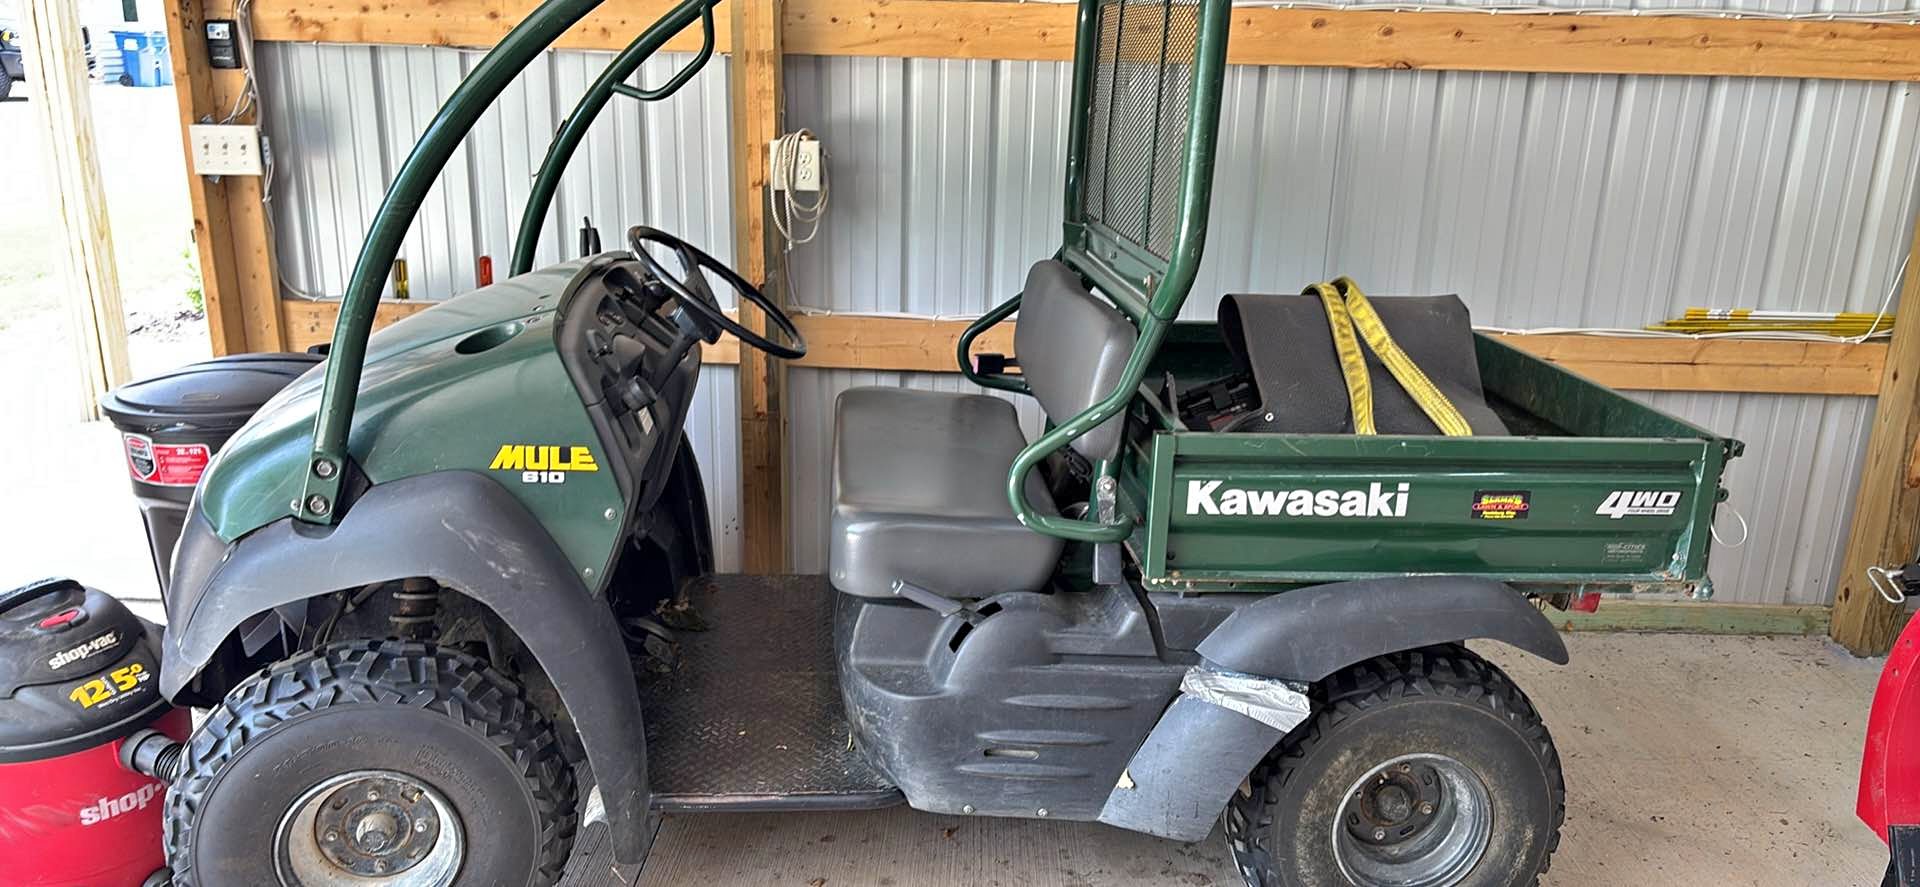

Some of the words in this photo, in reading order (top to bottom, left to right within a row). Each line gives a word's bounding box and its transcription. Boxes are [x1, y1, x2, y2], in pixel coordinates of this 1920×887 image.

[489, 445, 599, 471] MULE
[522, 471, 565, 483] 610
[1186, 480, 1410, 517] Kawasaki
[1595, 491, 1681, 519] 4WD
[69, 679, 113, 709] 12
